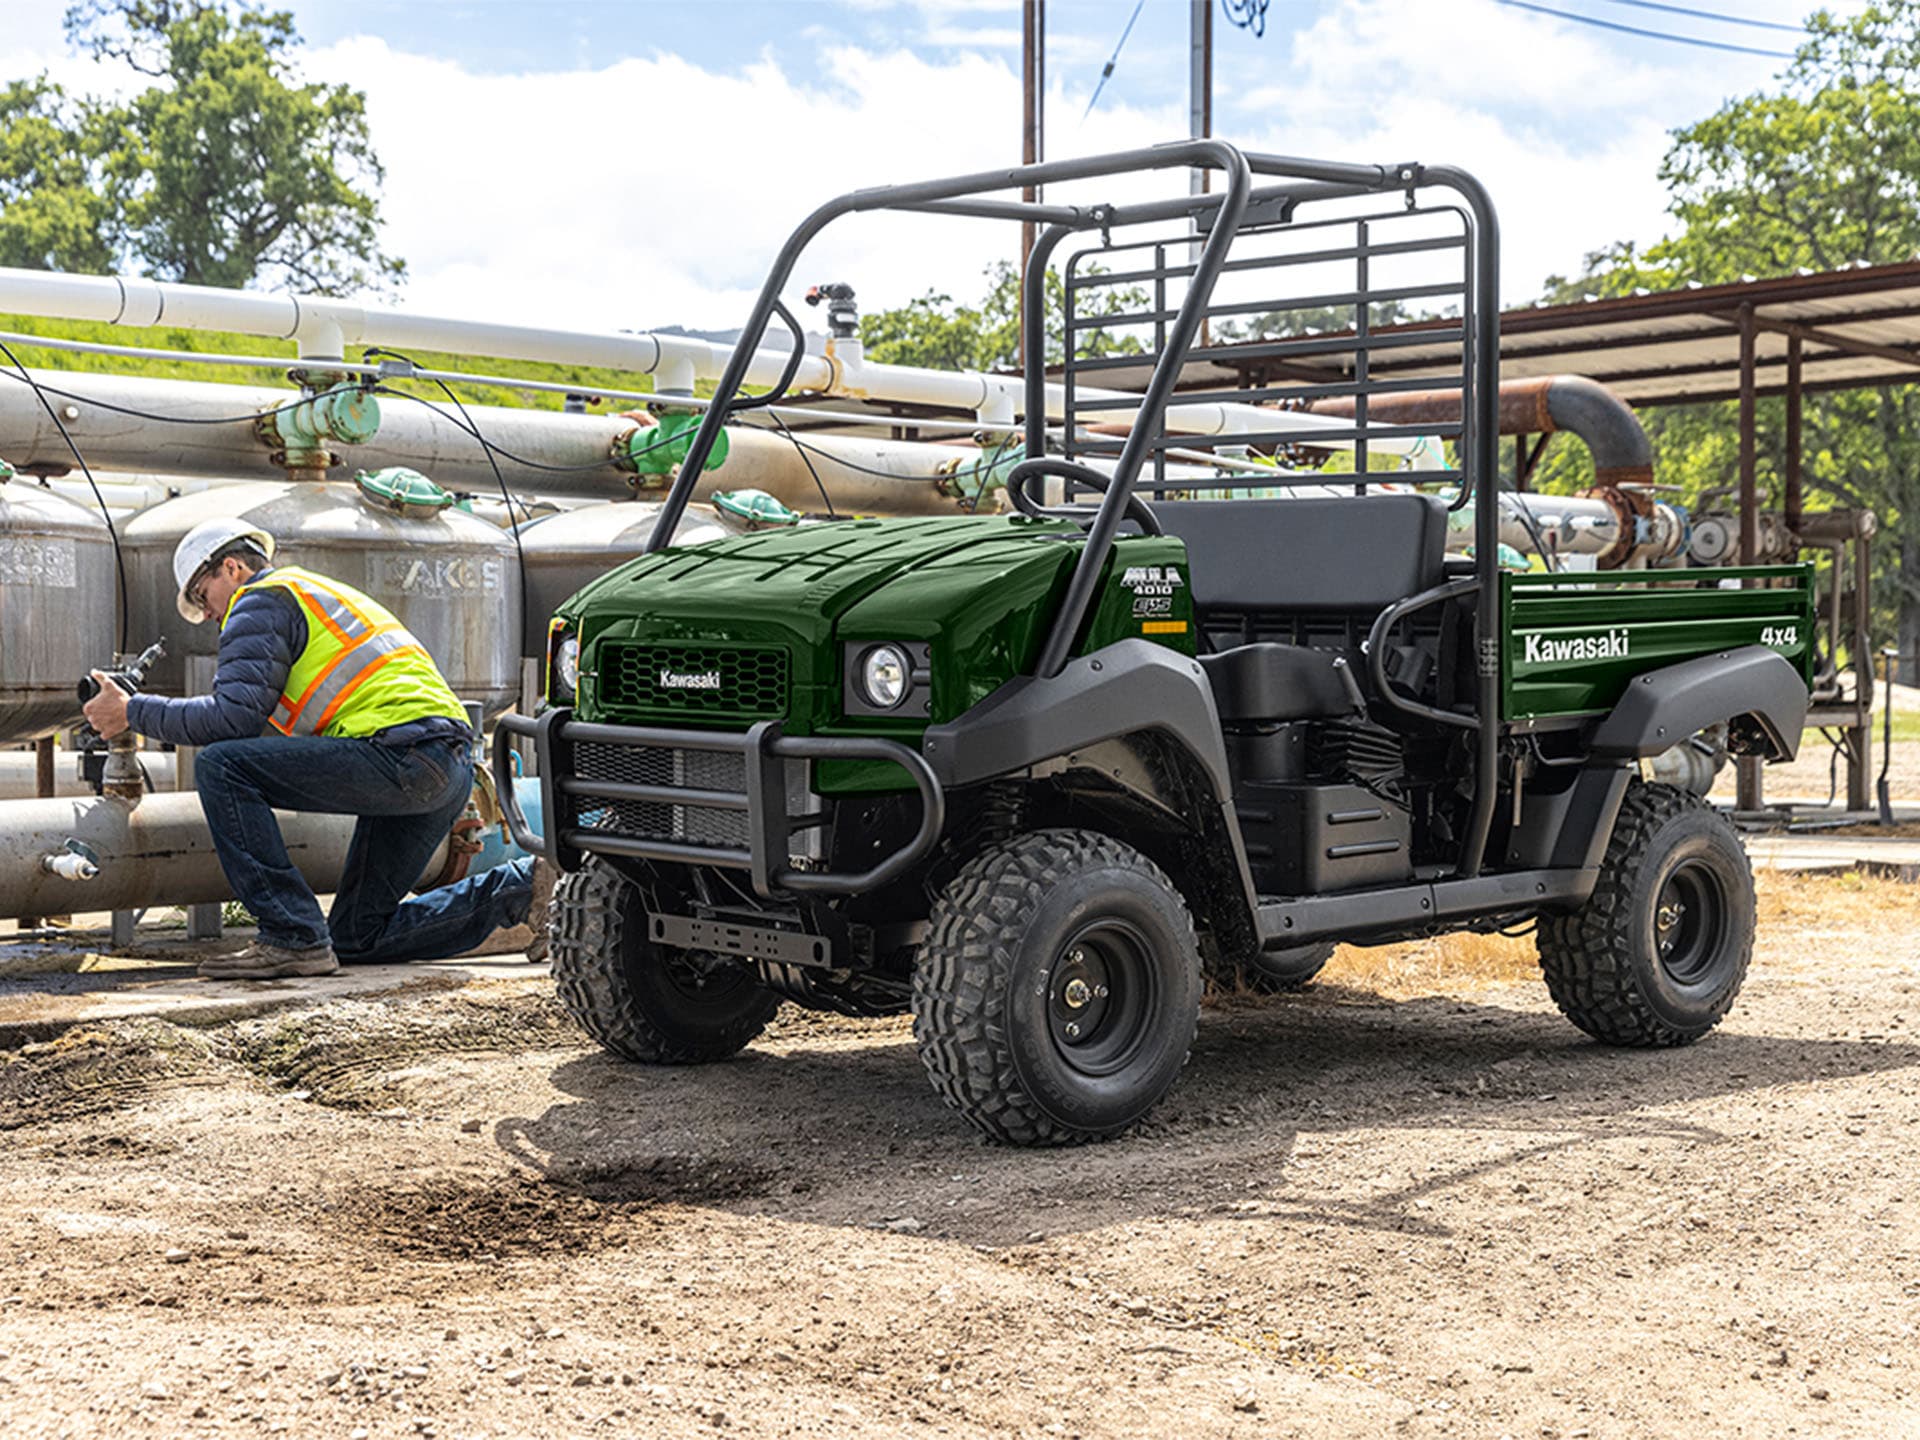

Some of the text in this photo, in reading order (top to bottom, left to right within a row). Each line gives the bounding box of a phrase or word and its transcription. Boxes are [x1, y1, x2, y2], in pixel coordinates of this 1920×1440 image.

[1133, 585, 1172, 595] 4010
[1525, 628, 1628, 663] Kawasaki
[1761, 625, 1797, 646] 4x4
[660, 669, 720, 689] Kawasaki
